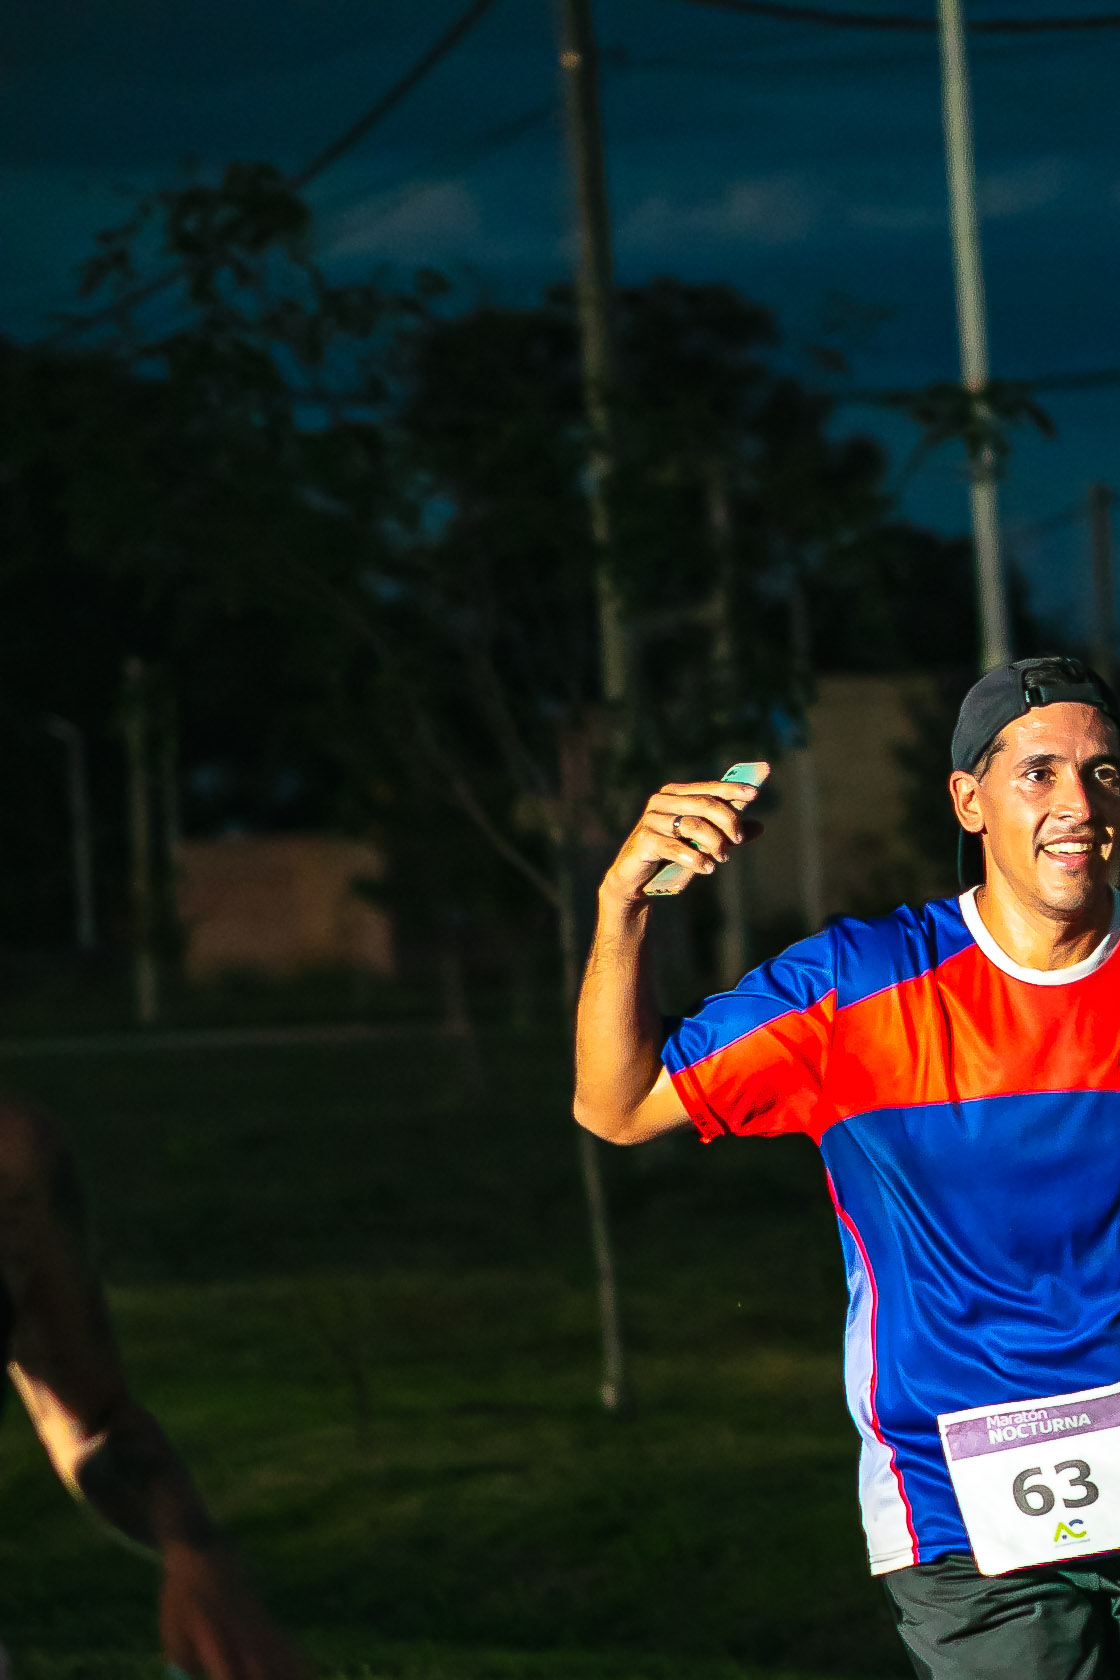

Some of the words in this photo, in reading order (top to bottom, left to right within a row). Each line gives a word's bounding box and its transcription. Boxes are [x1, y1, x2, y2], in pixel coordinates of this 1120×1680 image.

[986, 1409, 1048, 1429] Maratón
[988, 1413, 1091, 1445] NOCTURNA
[1013, 1459, 1099, 1516] 63
